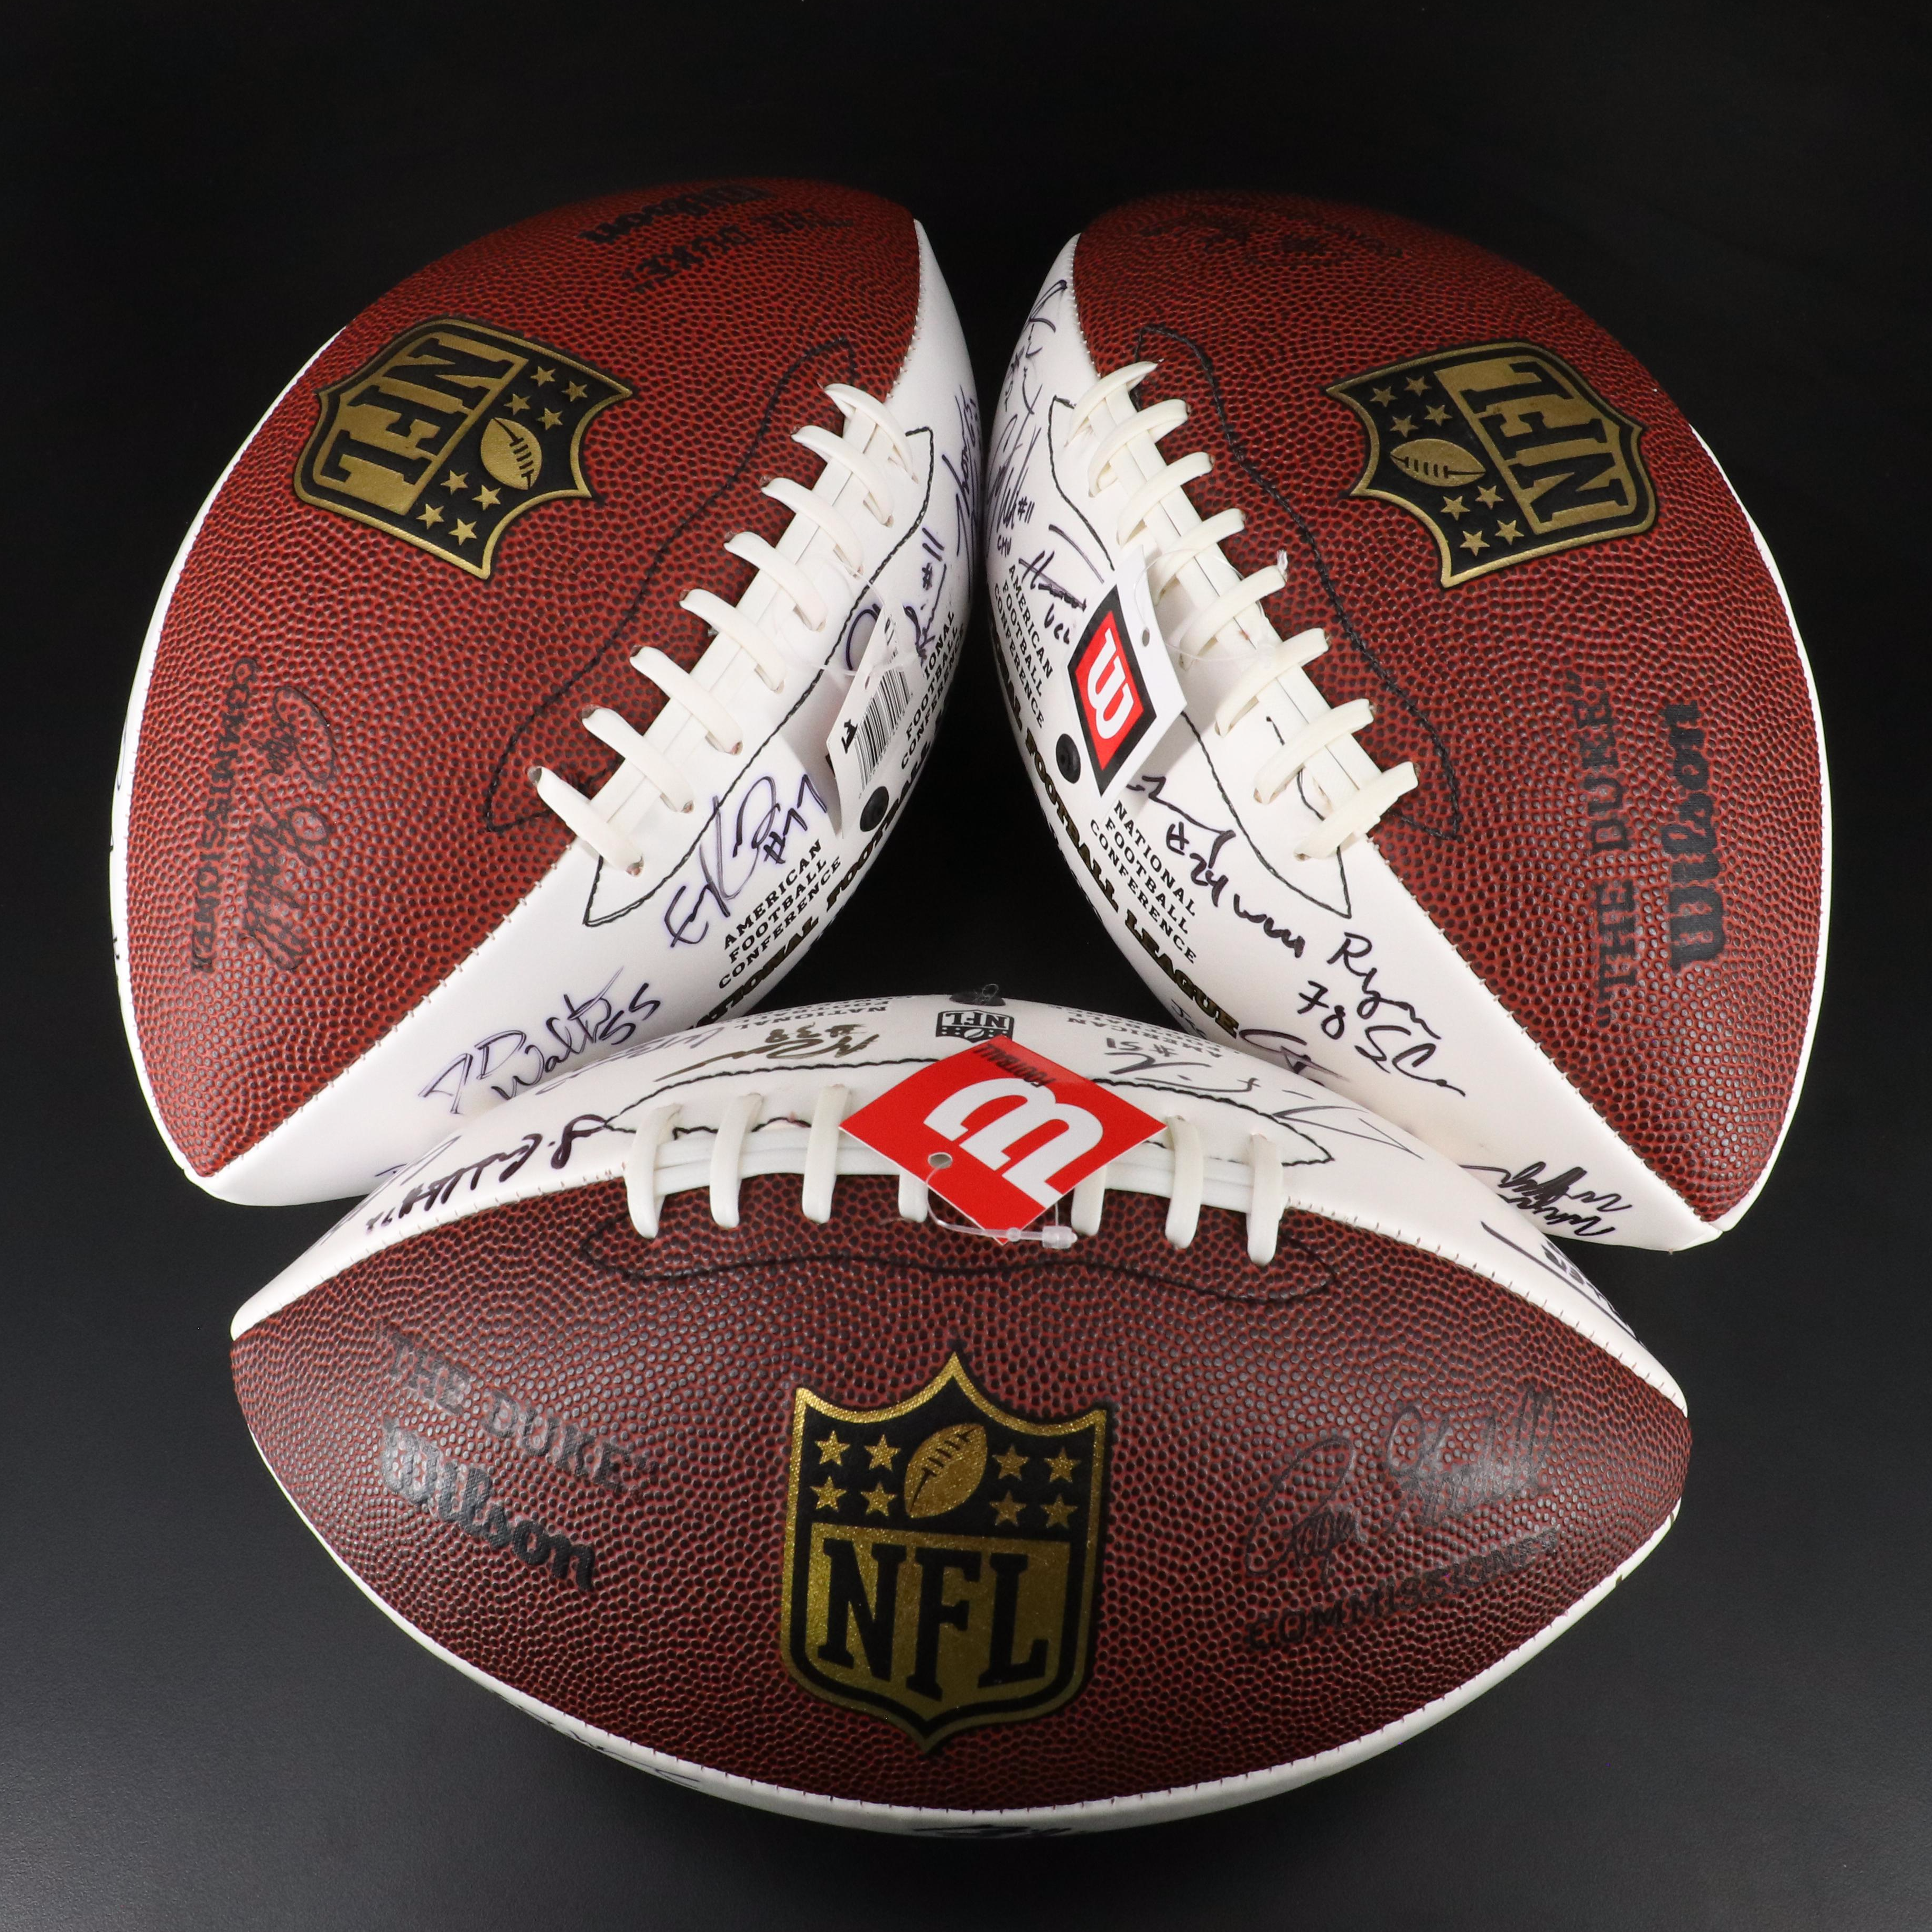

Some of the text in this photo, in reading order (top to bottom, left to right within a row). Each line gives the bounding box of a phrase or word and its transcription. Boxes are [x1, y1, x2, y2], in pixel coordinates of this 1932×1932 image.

[318, 337, 512, 485] NFL
[1459, 359, 1629, 526] NFL
[994, 583, 1044, 729] CONFERENCE
[1002, 579, 1043, 698] FOOTBALL
[1008, 564, 1053, 680] AMERICAN
[906, 626, 958, 741] FOOTBALL
[723, 838, 822, 950] AMERICAN
[1025, 728, 1120, 913] FOOTBALL
[1125, 909, 1240, 1039] LEAGUE
[1090, 819, 1198, 965] CONFERENCE
[1105, 816, 1188, 934] FOOTBALL
[1113, 800, 1196, 916] NATIONAL
[1659, 700, 1727, 975] Wilson
[719, 856, 841, 989] CONFERENCE
[729, 857, 828, 963] FOOTBALL
[687, 916, 821, 1030] ATIONAL
[735, 1006, 887, 1029] NATIONAL
[947, 1012, 1009, 1029] NFL
[972, 1043, 1057, 1089] FOOTBALL
[1067, 1017, 1223, 1058] AMERICAN
[380, 1414, 596, 1591] Wilson
[817, 1537, 1051, 1703] NFL
